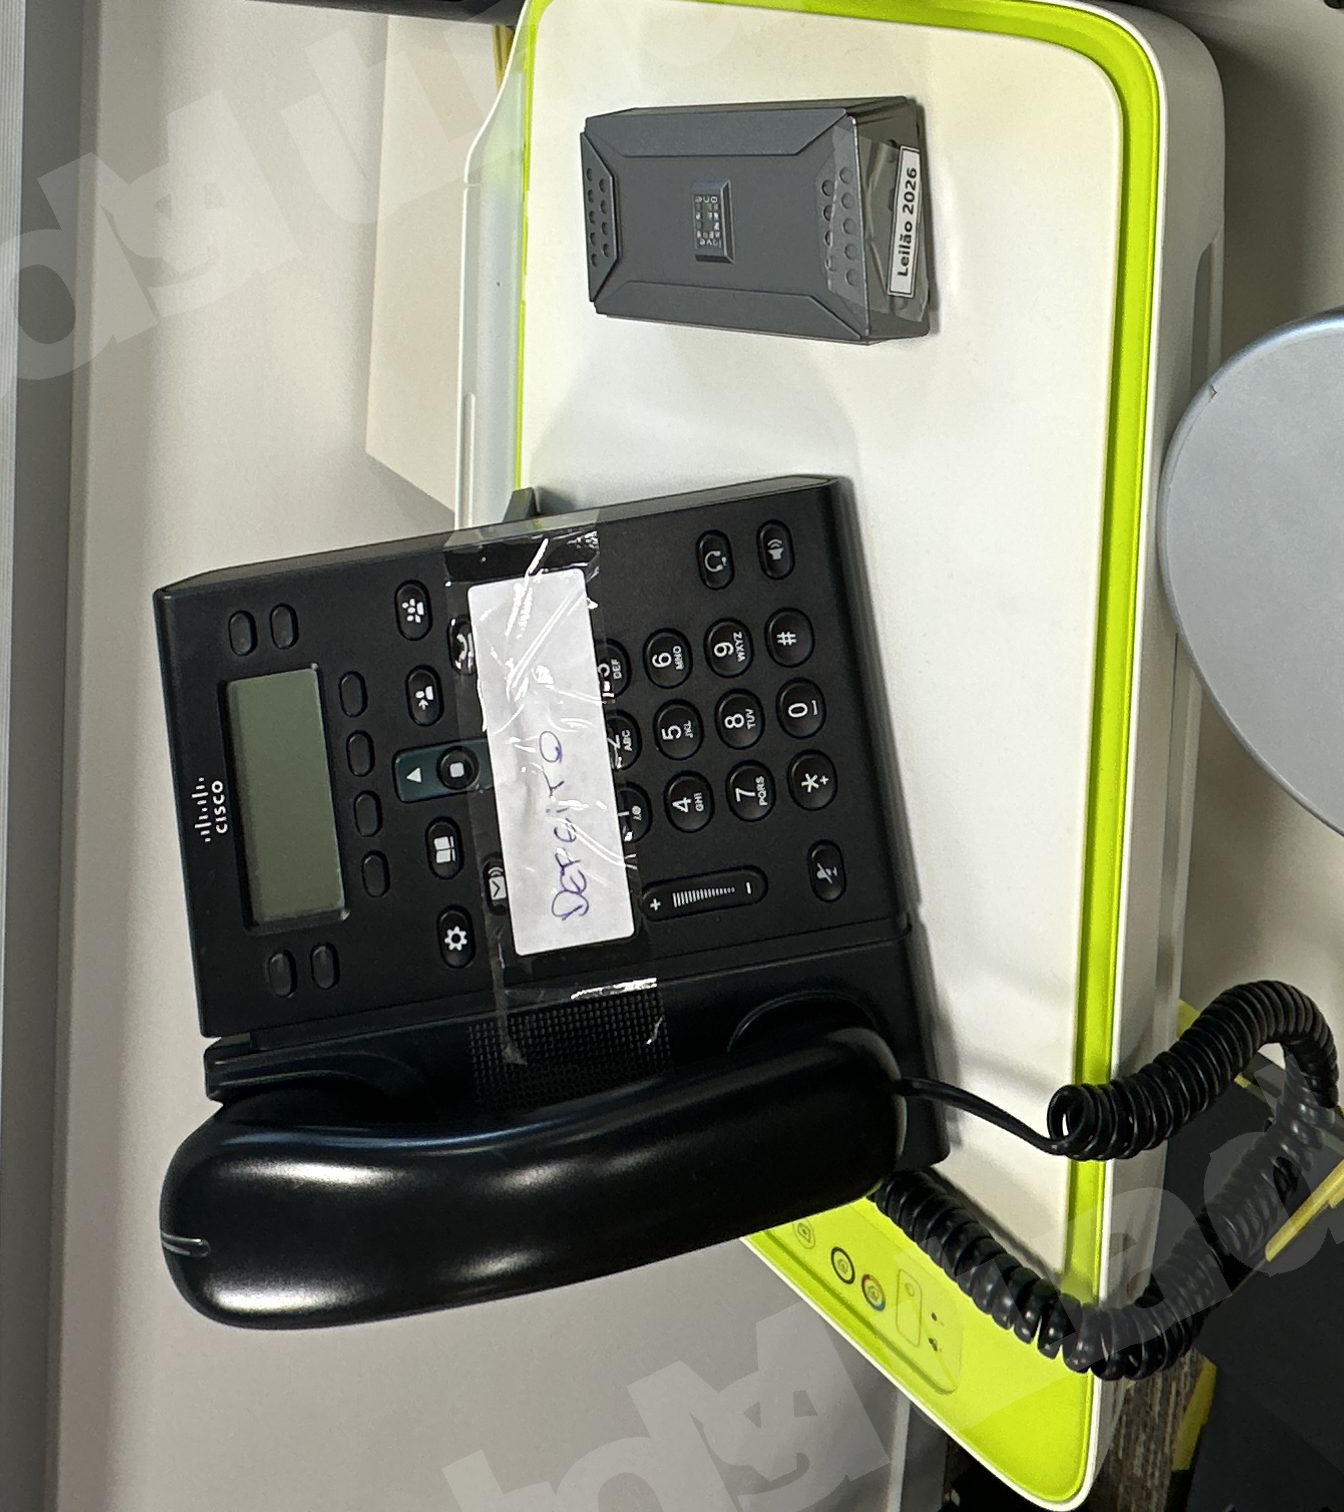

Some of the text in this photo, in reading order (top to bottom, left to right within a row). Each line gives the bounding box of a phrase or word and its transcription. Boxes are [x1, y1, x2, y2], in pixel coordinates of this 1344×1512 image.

[897, 167, 918, 276] Leilão 2026
[714, 641, 734, 658] 9
[733, 631, 746, 662] WXYZ
[611, 658, 622, 679] DEF
[652, 652, 672, 668] 6
[746, 708, 756, 730] TUV
[788, 702, 808, 718] 0
[724, 713, 745, 729] 8
[622, 730, 632, 751] ABC
[662, 724, 682, 740] 5
[735, 788, 756, 802] 7
[756, 776, 768, 806] PQRS
[211, 780, 228, 834] CISCO
[672, 797, 692, 812] 4
[694, 792, 704, 812] GHI
